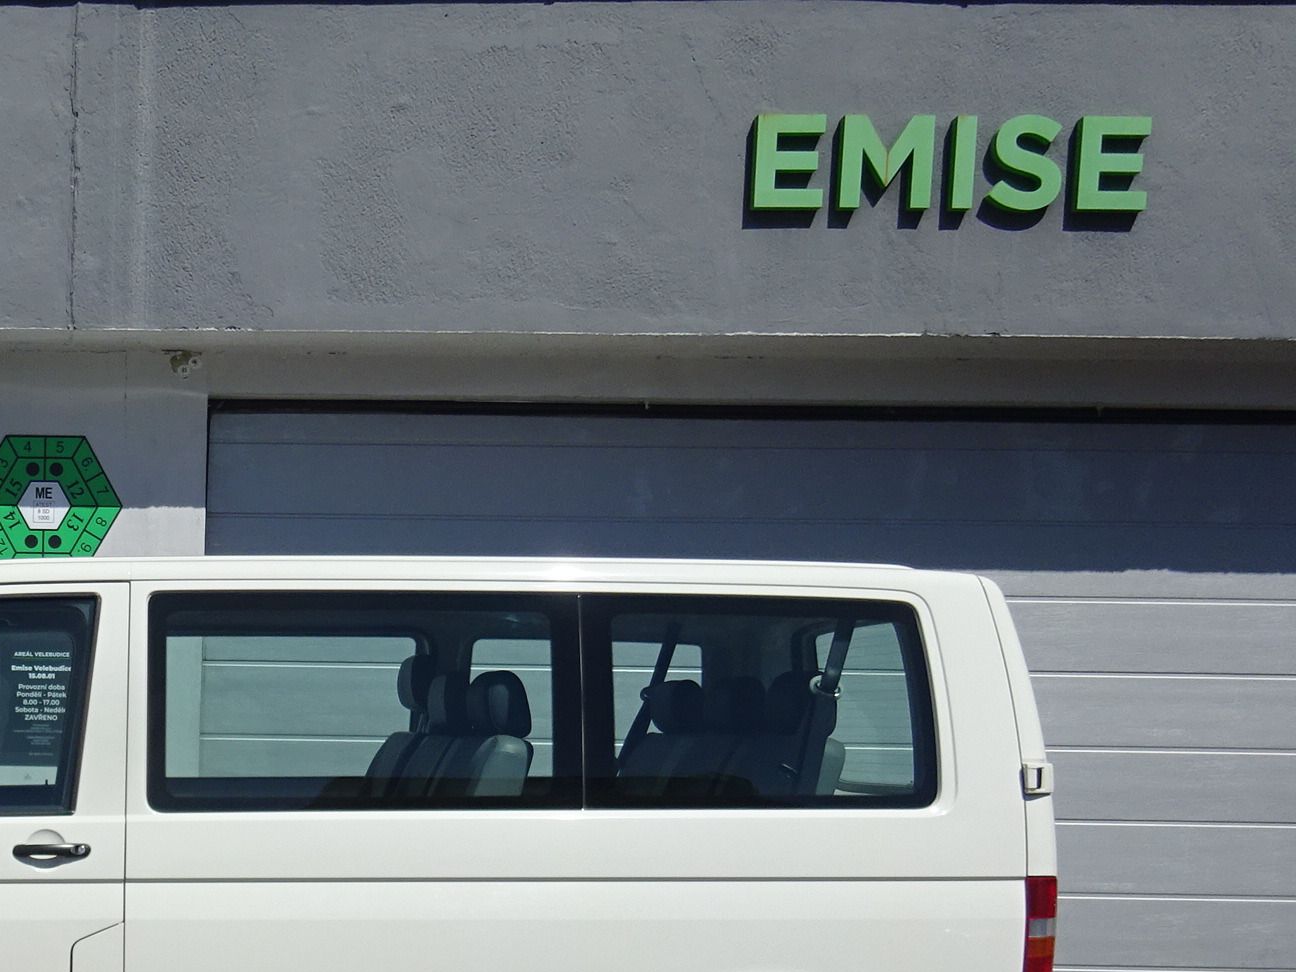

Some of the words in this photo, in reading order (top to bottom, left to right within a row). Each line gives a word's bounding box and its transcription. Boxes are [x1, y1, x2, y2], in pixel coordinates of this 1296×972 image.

[750, 113, 1152, 212] EMISE
[24, 441, 32, 453] 4
[55, 441, 65, 453] 5
[5, 478, 22, 497] 15
[35, 487, 53, 499] ME
[66, 480, 84, 499] 12
[97, 486, 109, 495] 7
[3, 511, 22, 529] 14
[66, 513, 85, 531] 13
[95, 516, 107, 527] 8
